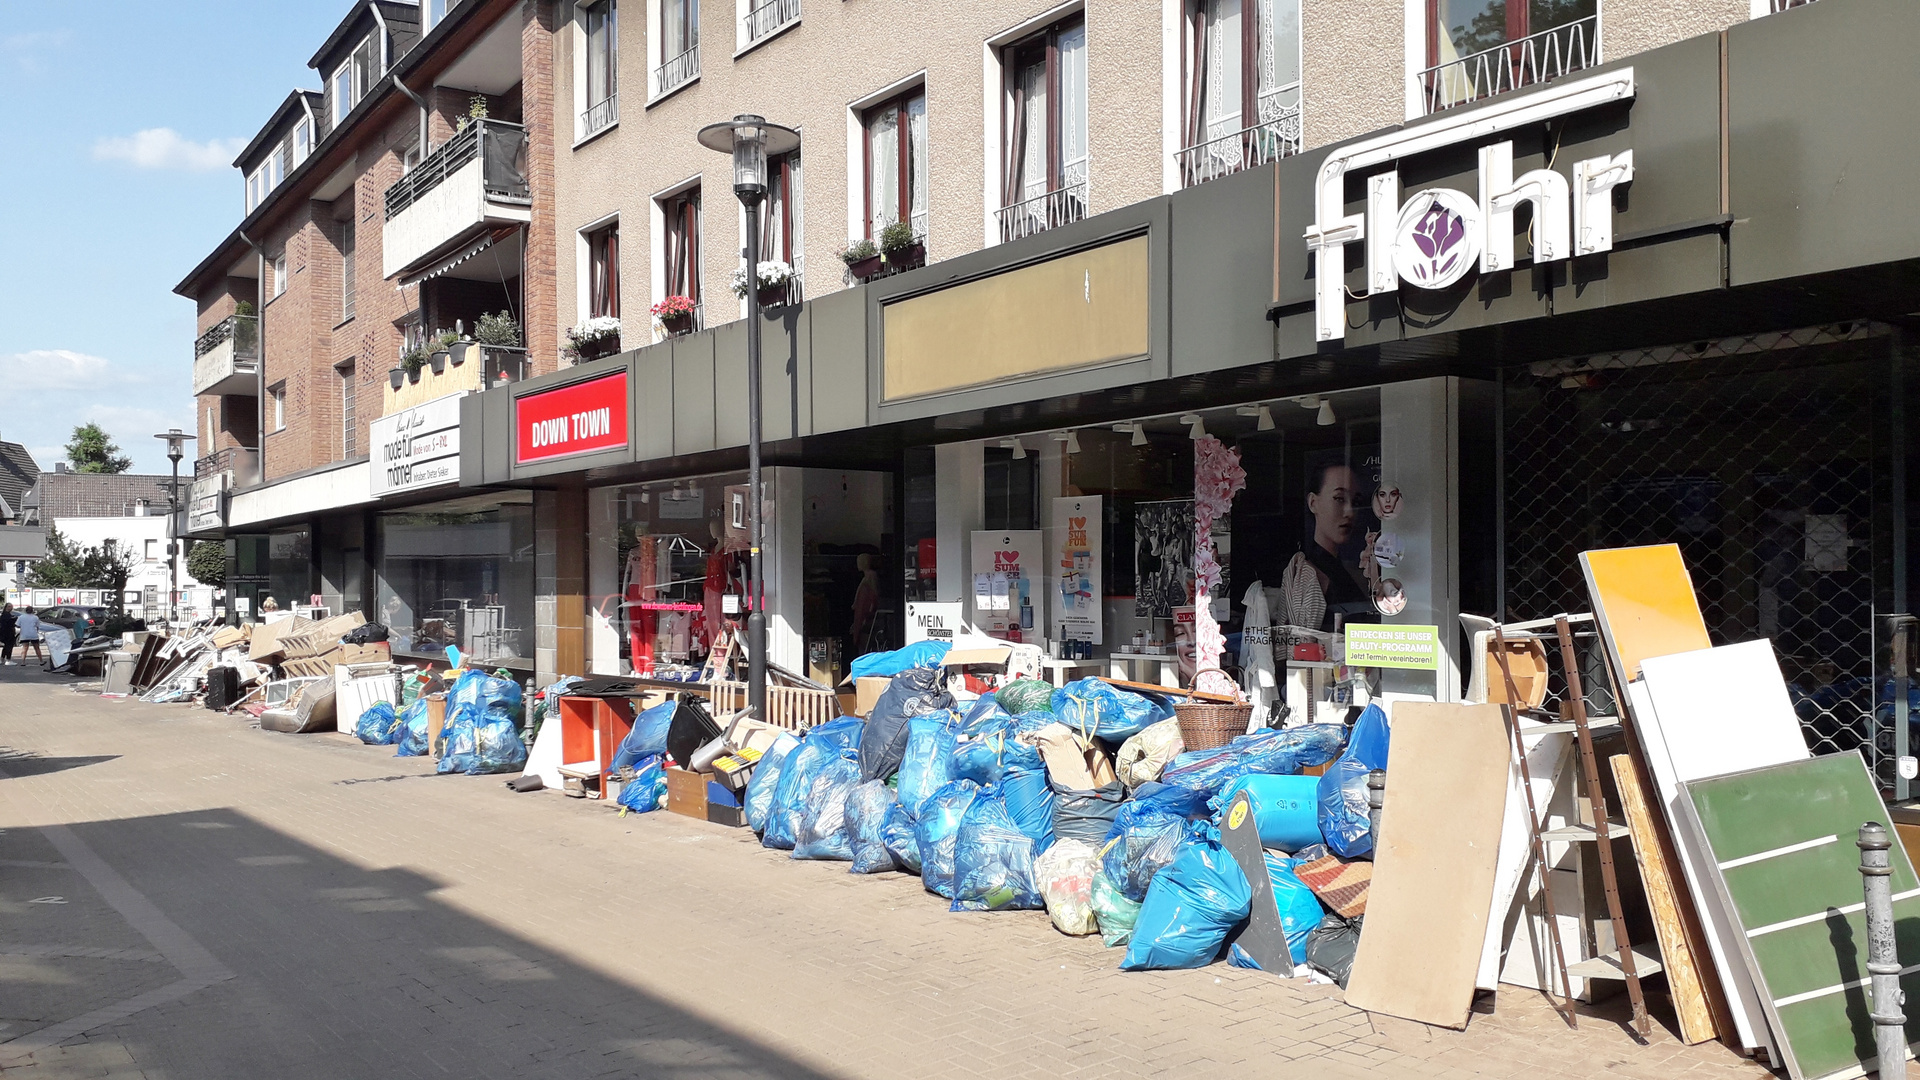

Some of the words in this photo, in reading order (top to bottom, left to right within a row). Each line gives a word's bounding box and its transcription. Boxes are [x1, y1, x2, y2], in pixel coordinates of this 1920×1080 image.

[1302, 66, 1635, 341] flohr
[532, 416, 568, 448] DOWN
[572, 406, 610, 440] TOWN
[384, 437, 402, 463] mode
[402, 434, 412, 458] für
[387, 462, 412, 487] männer
[994, 551, 1002, 564] I
[995, 563, 1020, 572] SUM
[918, 615, 943, 628] MEIN
[1245, 626, 1269, 635] #THE
[1350, 630, 1393, 639] ENTDECKEN
[1394, 631, 1406, 640] SIE
[1407, 632, 1432, 641] UNSER
[1245, 636, 1300, 646] FRAGRANCE
[1350, 641, 1433, 652] BEAUTY-PROGRAMM
[1366, 653, 1388, 661] Termin
[1389, 655, 1433, 663] vereinbaren!
